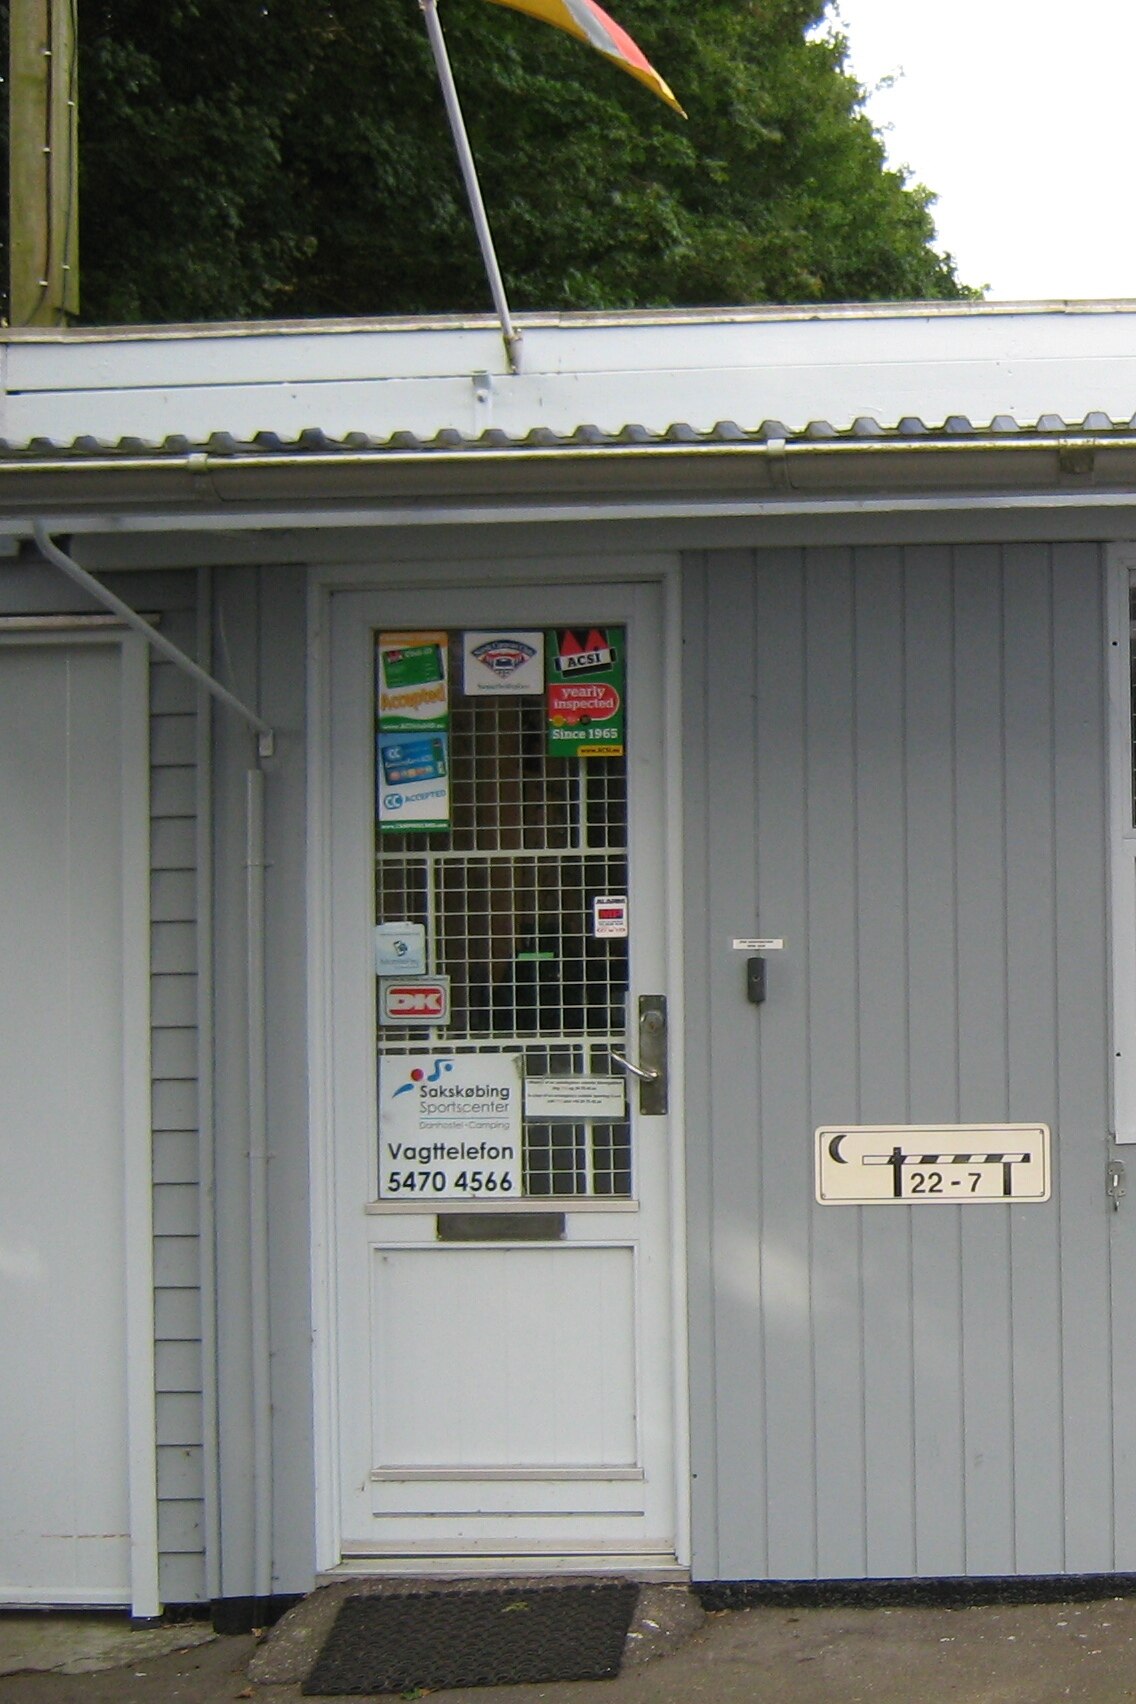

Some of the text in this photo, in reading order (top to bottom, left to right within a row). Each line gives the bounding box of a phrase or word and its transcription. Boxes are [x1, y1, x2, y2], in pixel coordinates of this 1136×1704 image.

[567, 651, 602, 668] ACSI
[562, 685, 606, 700] yearly
[554, 697, 614, 711] inspected
[552, 728, 618, 740] Since 1965
[405, 789, 447, 803] ACCEPTED
[419, 1084, 510, 1101] Sakskøbing
[419, 1100, 510, 1115] Sportscenter
[387, 1142, 514, 1165] Vagttelefon
[387, 1170, 513, 1192] 5470 4566
